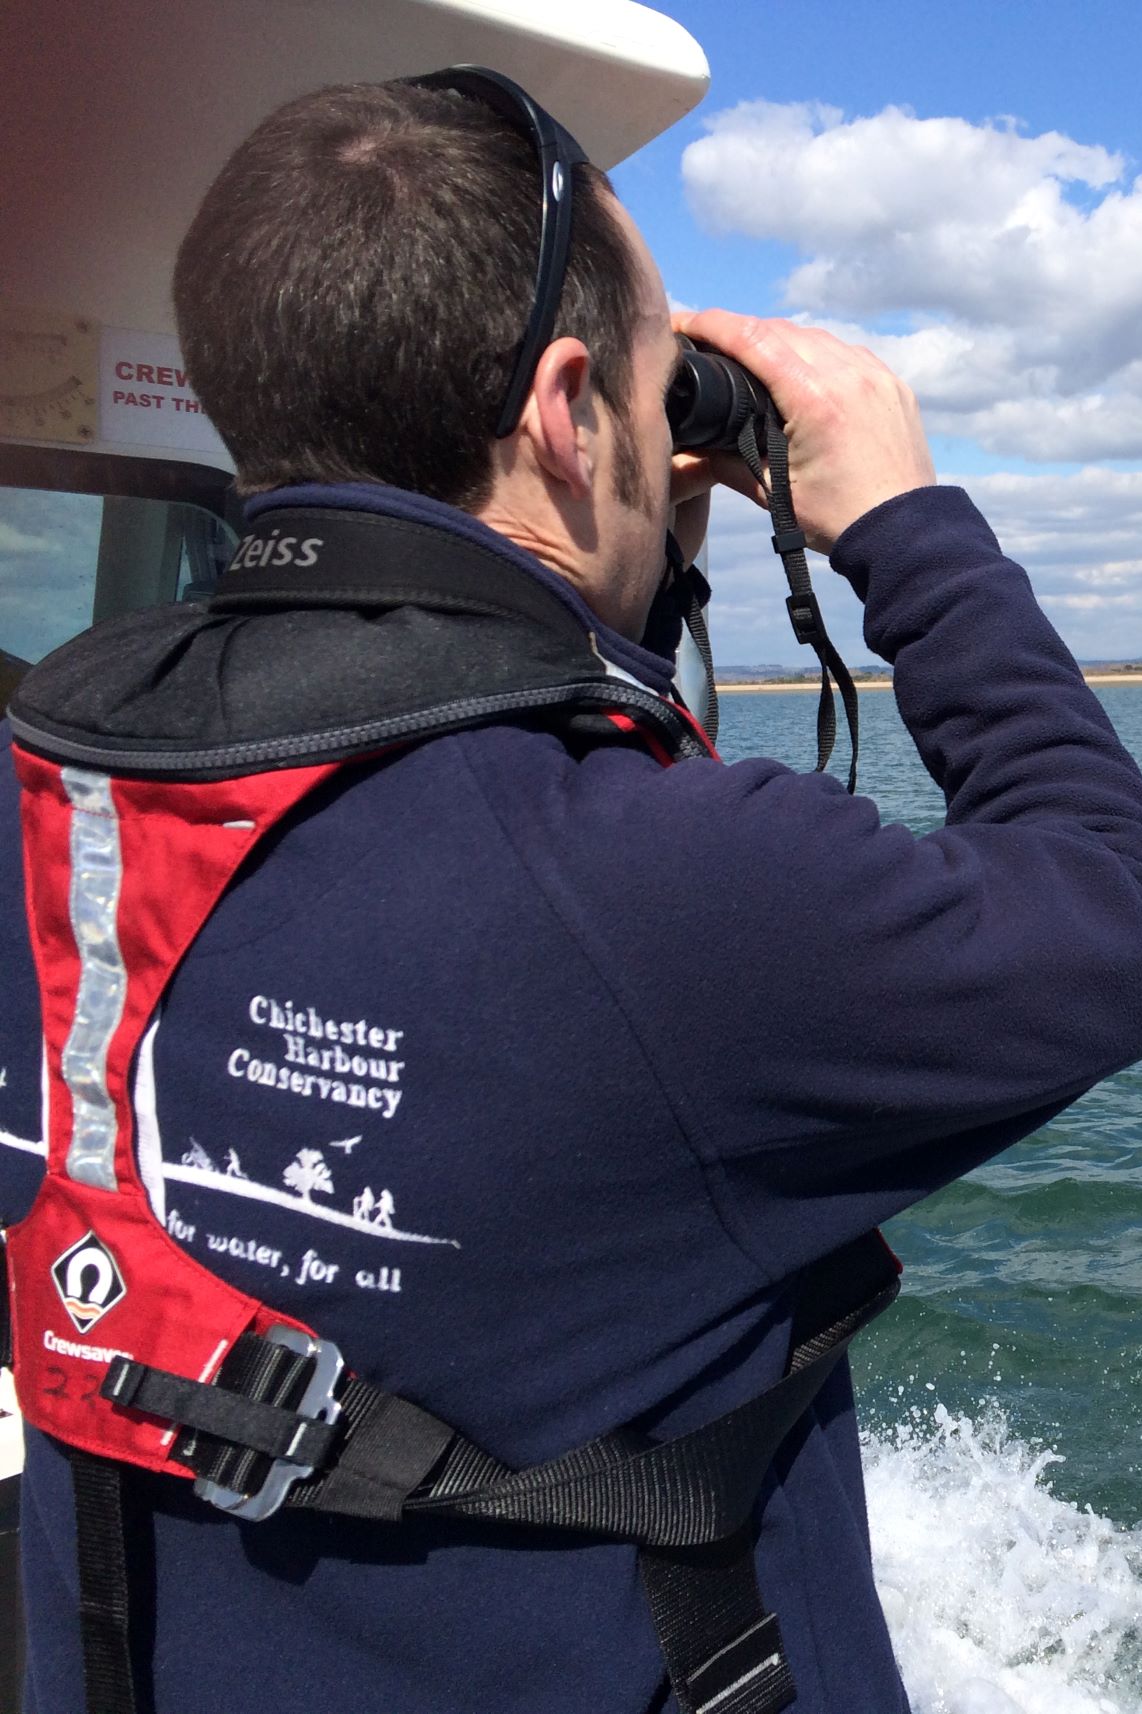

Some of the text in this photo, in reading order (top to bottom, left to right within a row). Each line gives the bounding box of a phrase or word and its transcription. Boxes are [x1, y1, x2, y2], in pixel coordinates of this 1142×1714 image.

[113, 390, 206, 414] PAST TH
[229, 529, 324, 571] Zeiss
[250, 995, 403, 1051] Chichester
[227, 1048, 402, 1118] Conservancy
[283, 1033, 405, 1082] Harbour
[206, 1233, 289, 1277] water,
[295, 1249, 339, 1285] for
[355, 1266, 401, 1292] all
